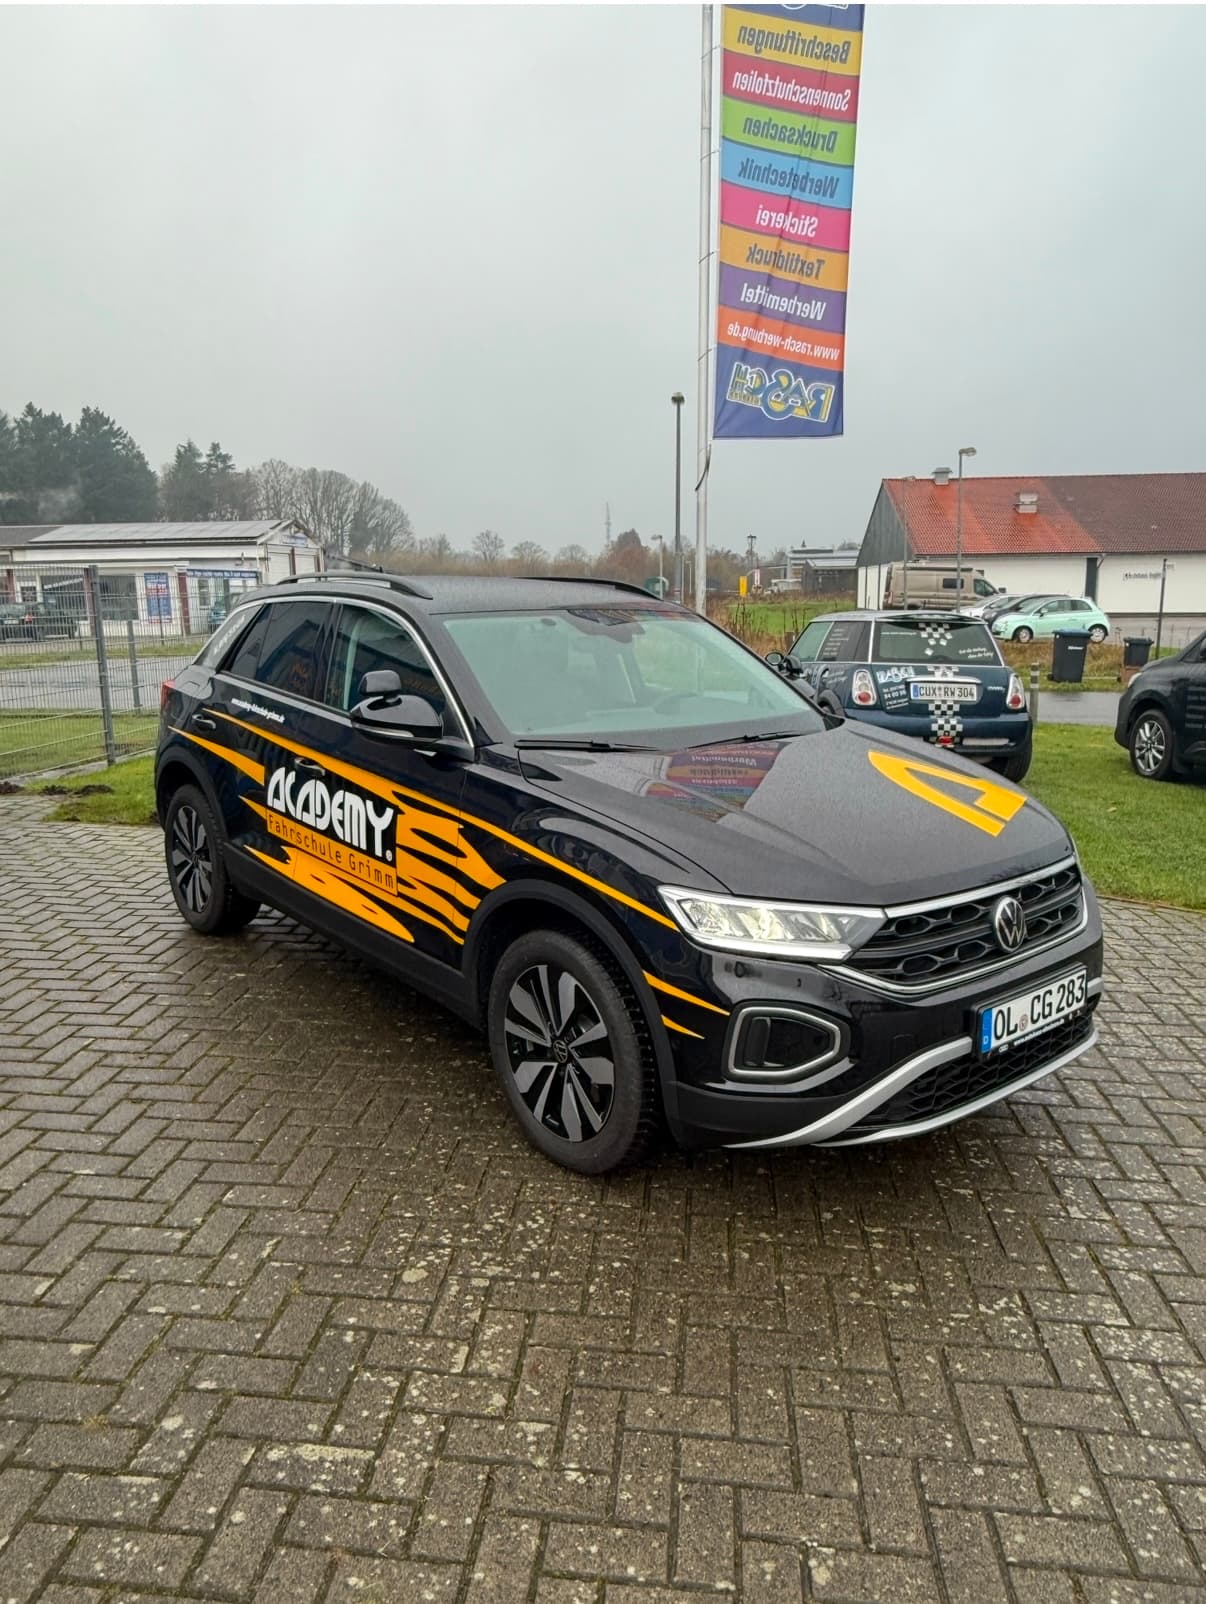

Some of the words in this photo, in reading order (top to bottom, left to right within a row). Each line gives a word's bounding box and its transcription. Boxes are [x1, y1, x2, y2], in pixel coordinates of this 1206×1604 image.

[919, 686, 937, 697] CUX
[944, 686, 956, 697] RW
[957, 687, 975, 697] 304
[268, 816, 342, 864] Fahrschule
[349, 853, 394, 889] Grimm
[993, 1006, 1018, 1041] OL
[1030, 989, 1053, 1025] CG
[1056, 974, 1086, 1014] 283
